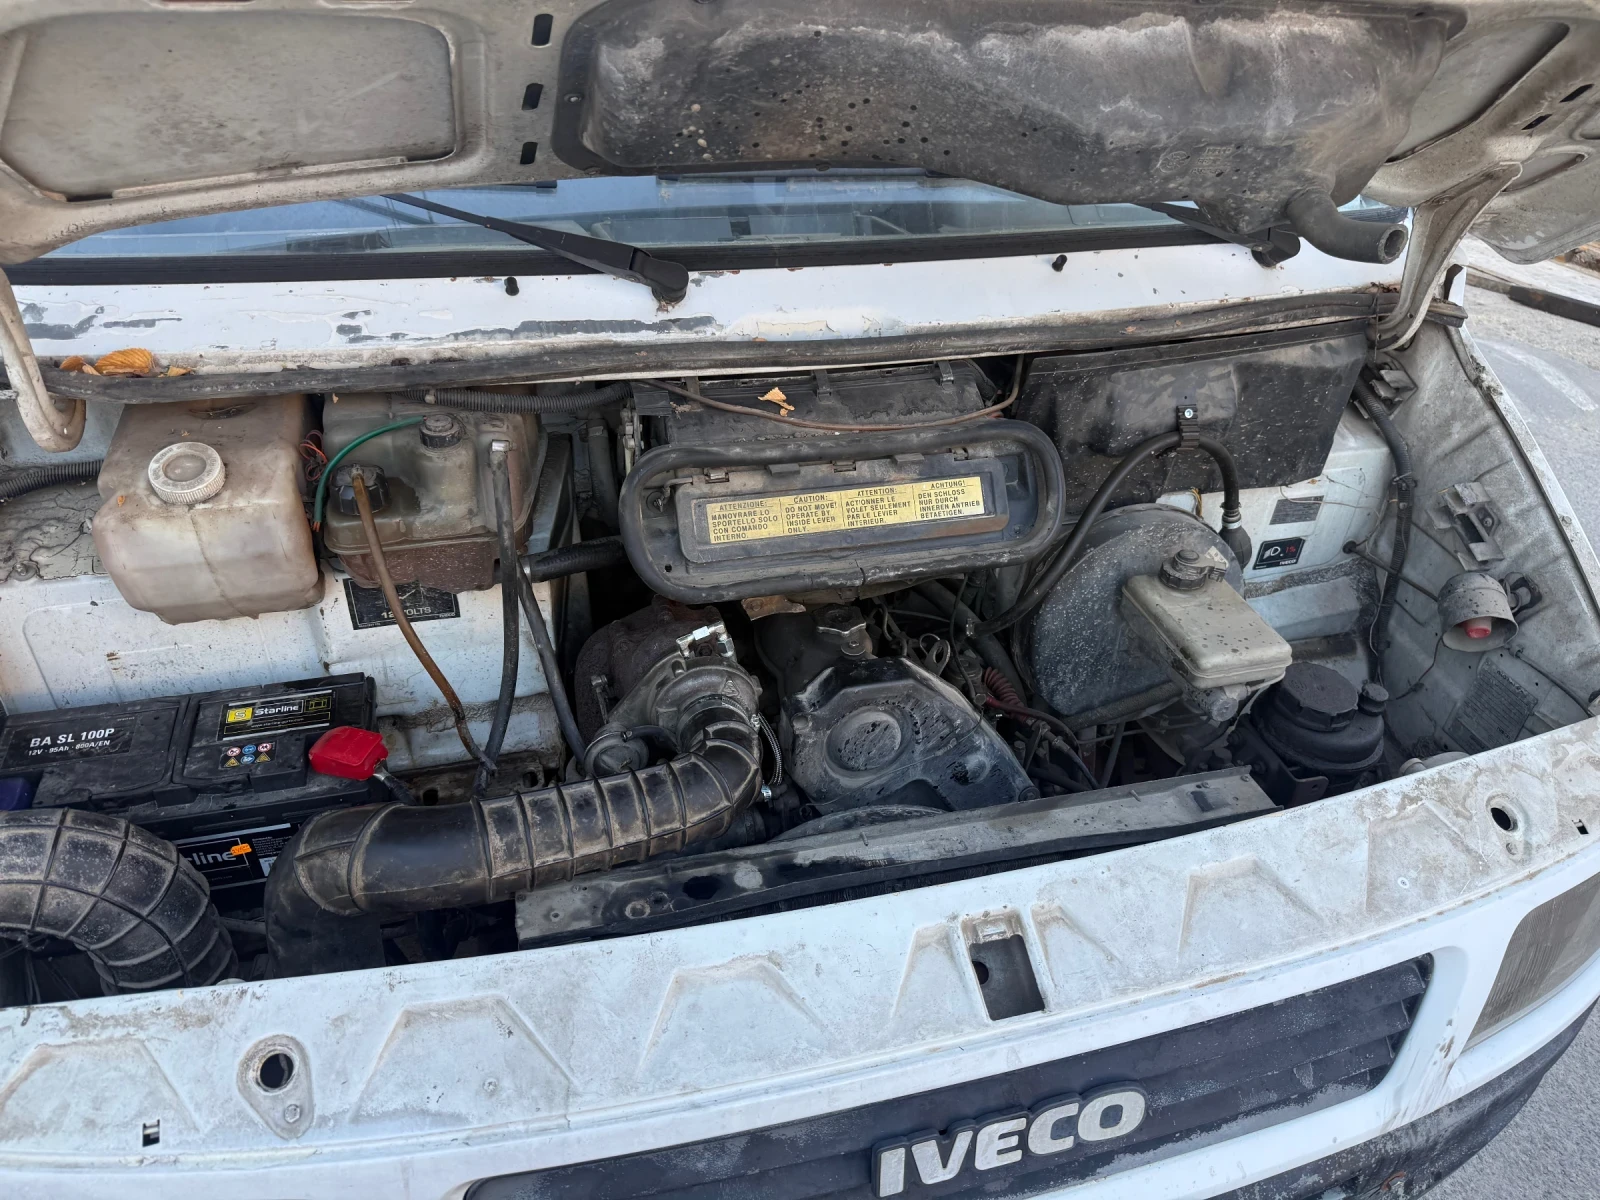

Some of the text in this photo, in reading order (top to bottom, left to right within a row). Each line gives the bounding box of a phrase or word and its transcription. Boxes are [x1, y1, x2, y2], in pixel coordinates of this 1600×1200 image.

[931, 480, 966, 489] ACHTUNG!
[858, 487, 898, 496] ATTENTION:
[934, 489, 966, 498] SCHLOSS
[794, 494, 828, 504] CAUTION:
[845, 498, 885, 507] ACTIONNER
[935, 496, 959, 504] DURCH
[719, 501, 767, 511] ATTENZIONE:
[798, 504, 812, 512] NOT
[815, 502, 837, 510] MOVE!
[846, 500, 911, 514] VOLET SEULEMENT
[919, 500, 980, 512] INNEREN ANTRIEB
[711, 509, 758, 521] MANOVRARE
[786, 511, 818, 520] OPERATE
[874, 510, 898, 518] LEVIER
[920, 509, 965, 519] BETAETIGEN.
[712, 515, 778, 528] SPORTELLO SOLO
[786, 516, 836, 527] INSIDE LEVER
[848, 518, 887, 527] INTERIEUR.
[713, 524, 768, 535] CON COMANDO
[788, 526, 810, 534] ONLY.
[714, 533, 749, 542] INTERNO.
[403, 606, 432, 616] OLTS
[254, 705, 299, 716] Starline
[30, 727, 115, 748] BA SL 100P
[28, 748, 43, 757] 12V
[879, 1090, 1147, 1198] IVECO
